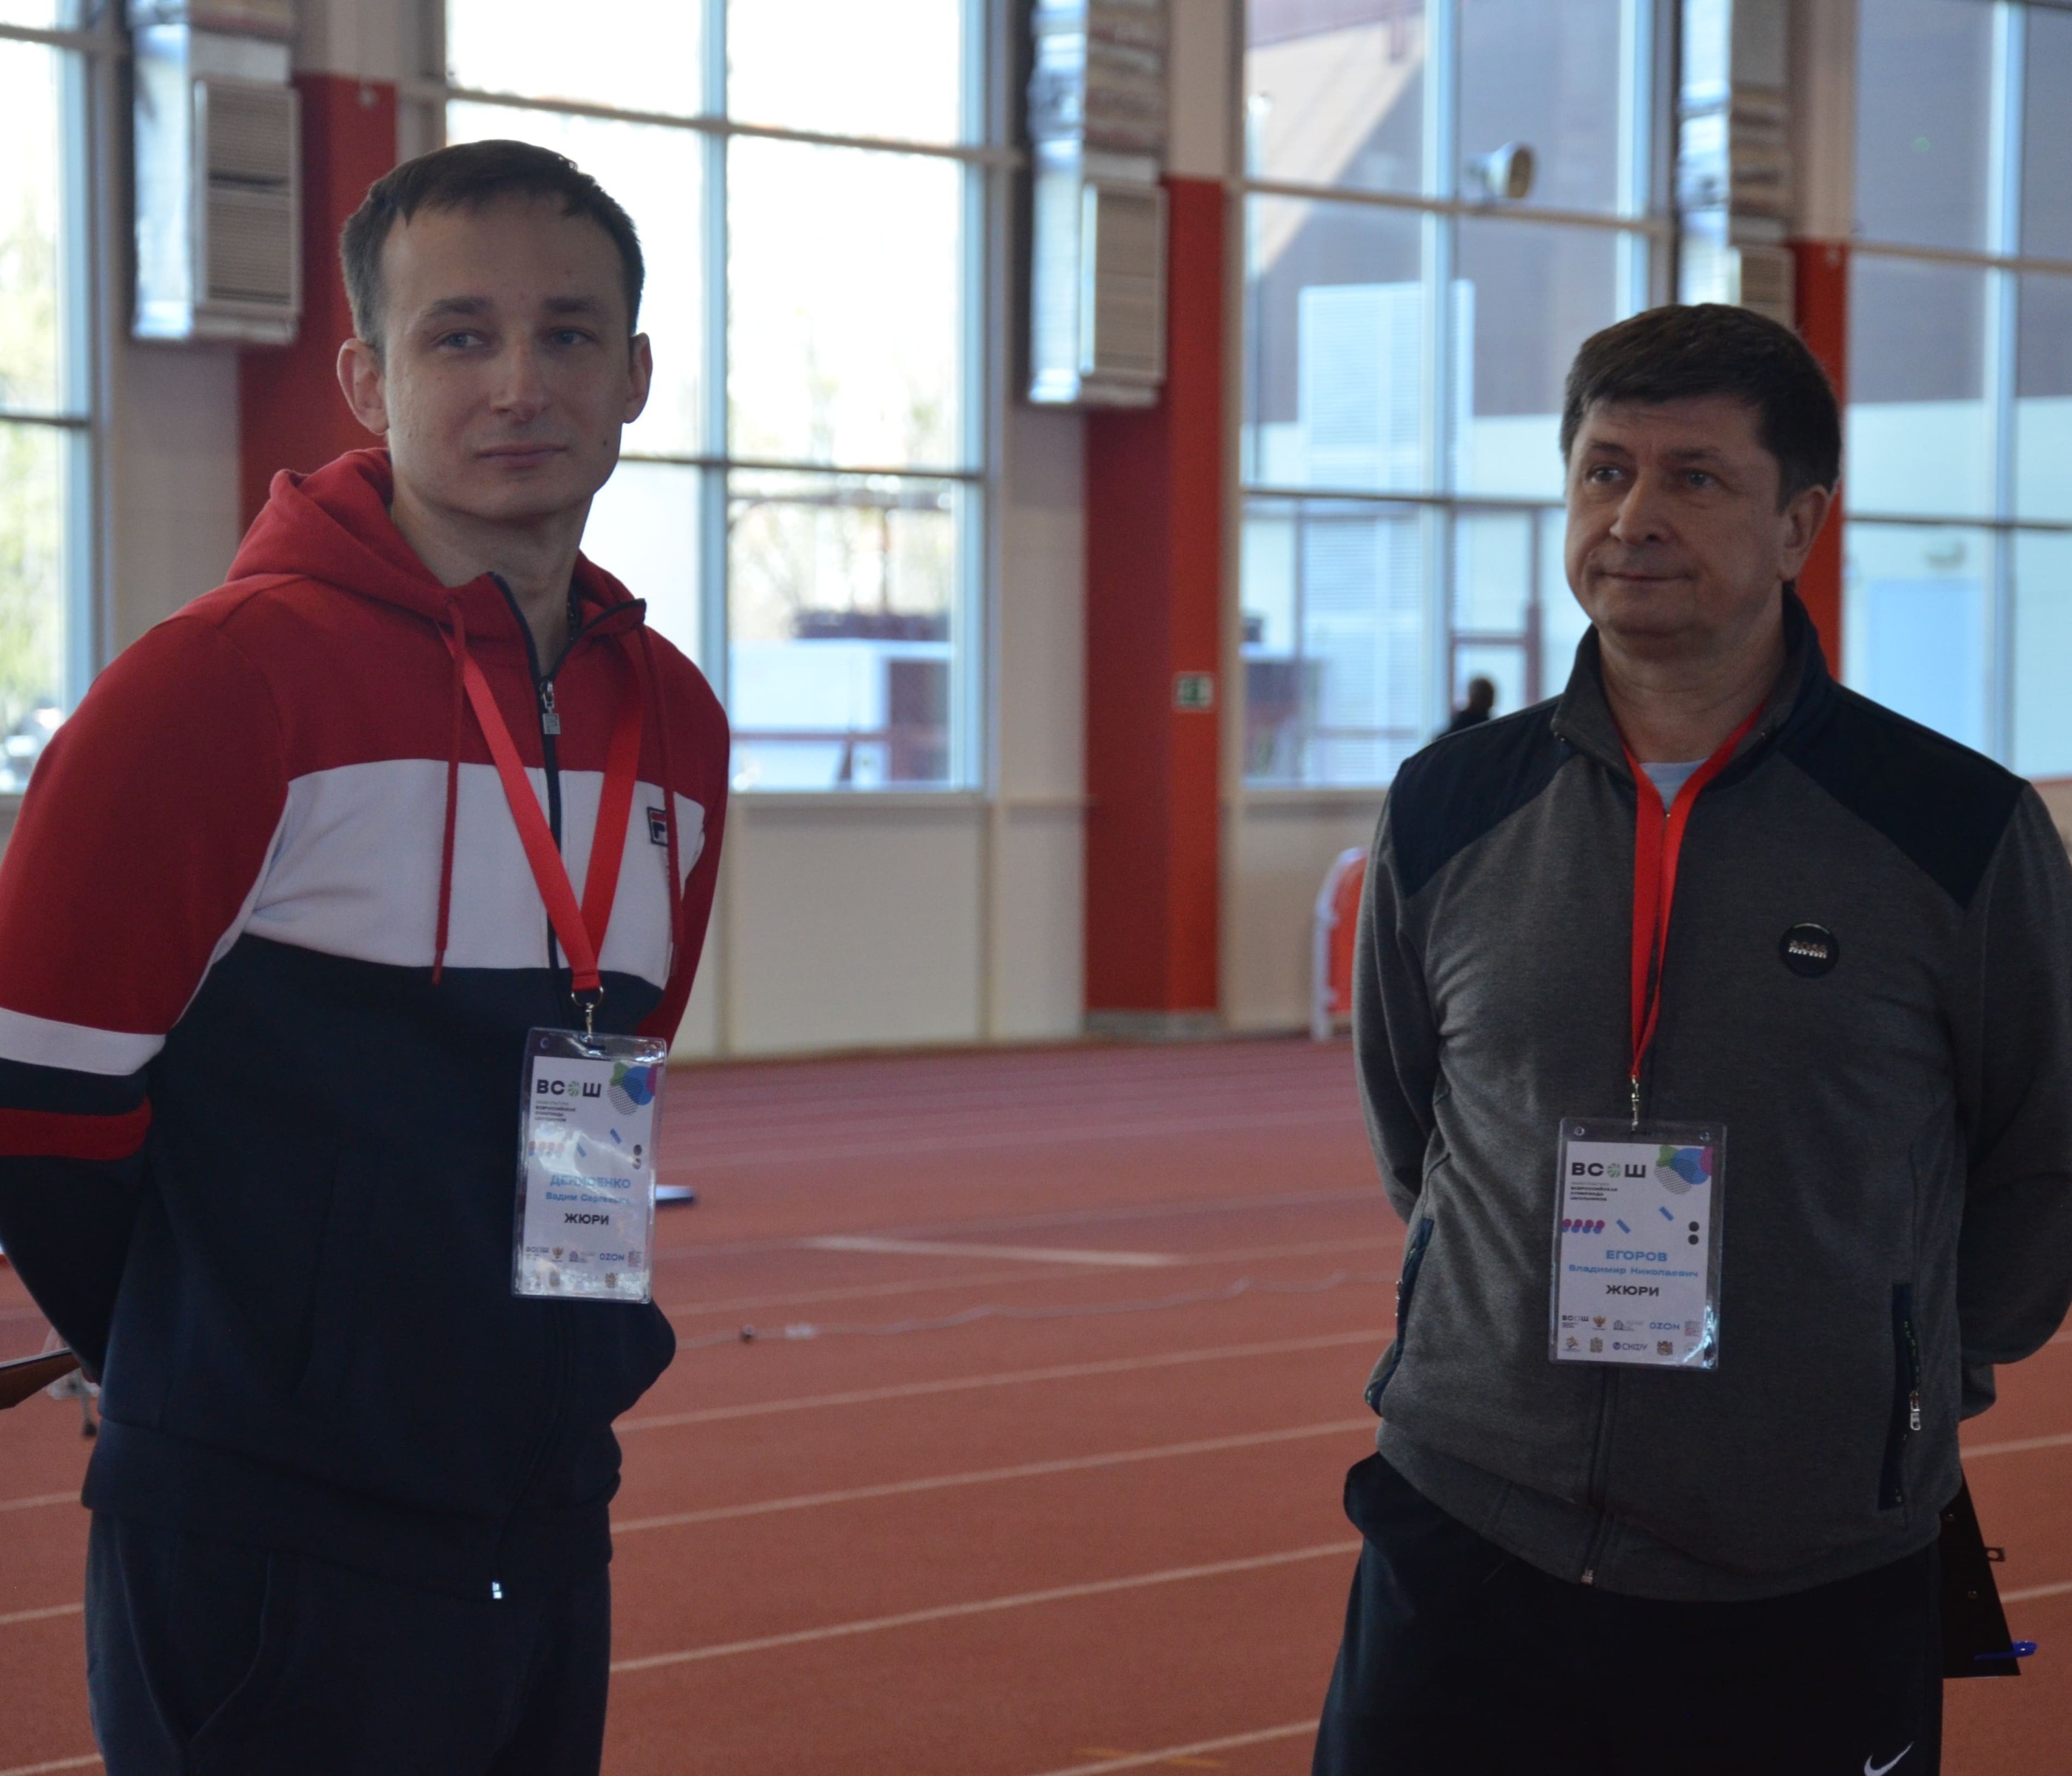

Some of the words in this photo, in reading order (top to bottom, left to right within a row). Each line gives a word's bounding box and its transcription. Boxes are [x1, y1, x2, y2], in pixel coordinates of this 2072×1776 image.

[545, 1192, 577, 1201] Вадим
[564, 1213, 609, 1225] ЖЮРИ
[599, 1253, 625, 1261] OZON
[1606, 1250, 1668, 1262] ЕГОРОВ
[1568, 1265, 1626, 1275] Владимир
[1630, 1267, 1698, 1278] Николаевич
[1606, 1285, 1660, 1296] ЖЮРИ
[1649, 1322, 1681, 1330] OZON
